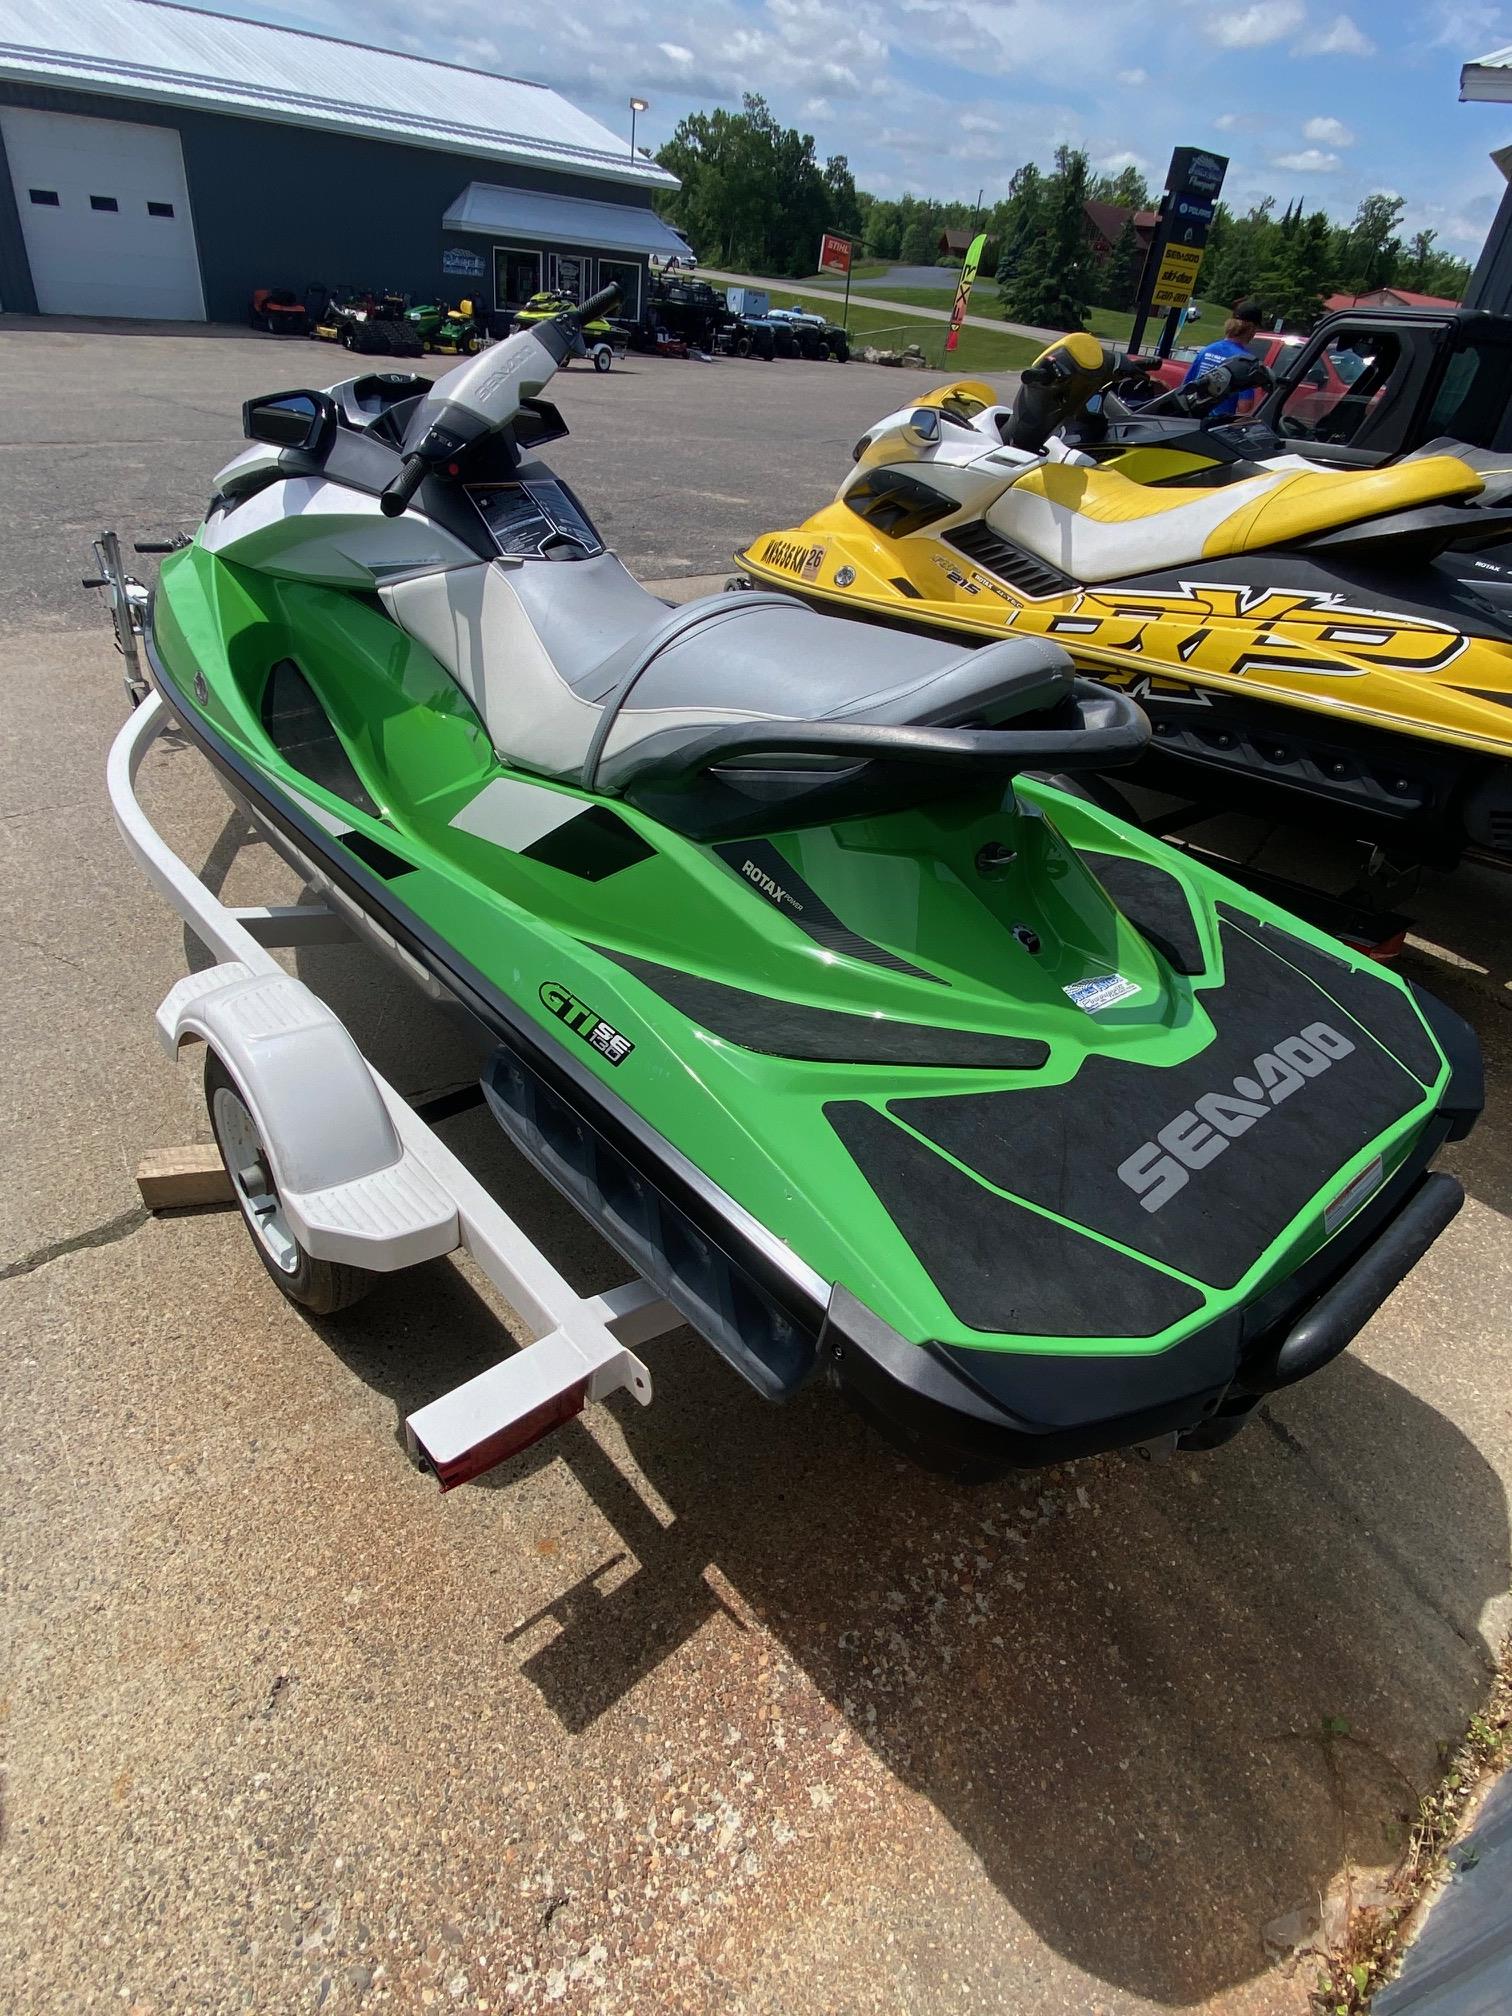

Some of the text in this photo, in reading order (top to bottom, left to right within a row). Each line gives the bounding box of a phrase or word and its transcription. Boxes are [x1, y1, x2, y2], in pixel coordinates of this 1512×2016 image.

[827, 239, 849, 254] STIHL
[806, 548, 824, 568] 26
[1474, 561, 1502, 572] ROTAX
[946, 571, 982, 595] 215
[973, 573, 994, 589] ROTAX
[742, 860, 804, 912] ROTAX POWER
[539, 981, 631, 1055] GTI SE
